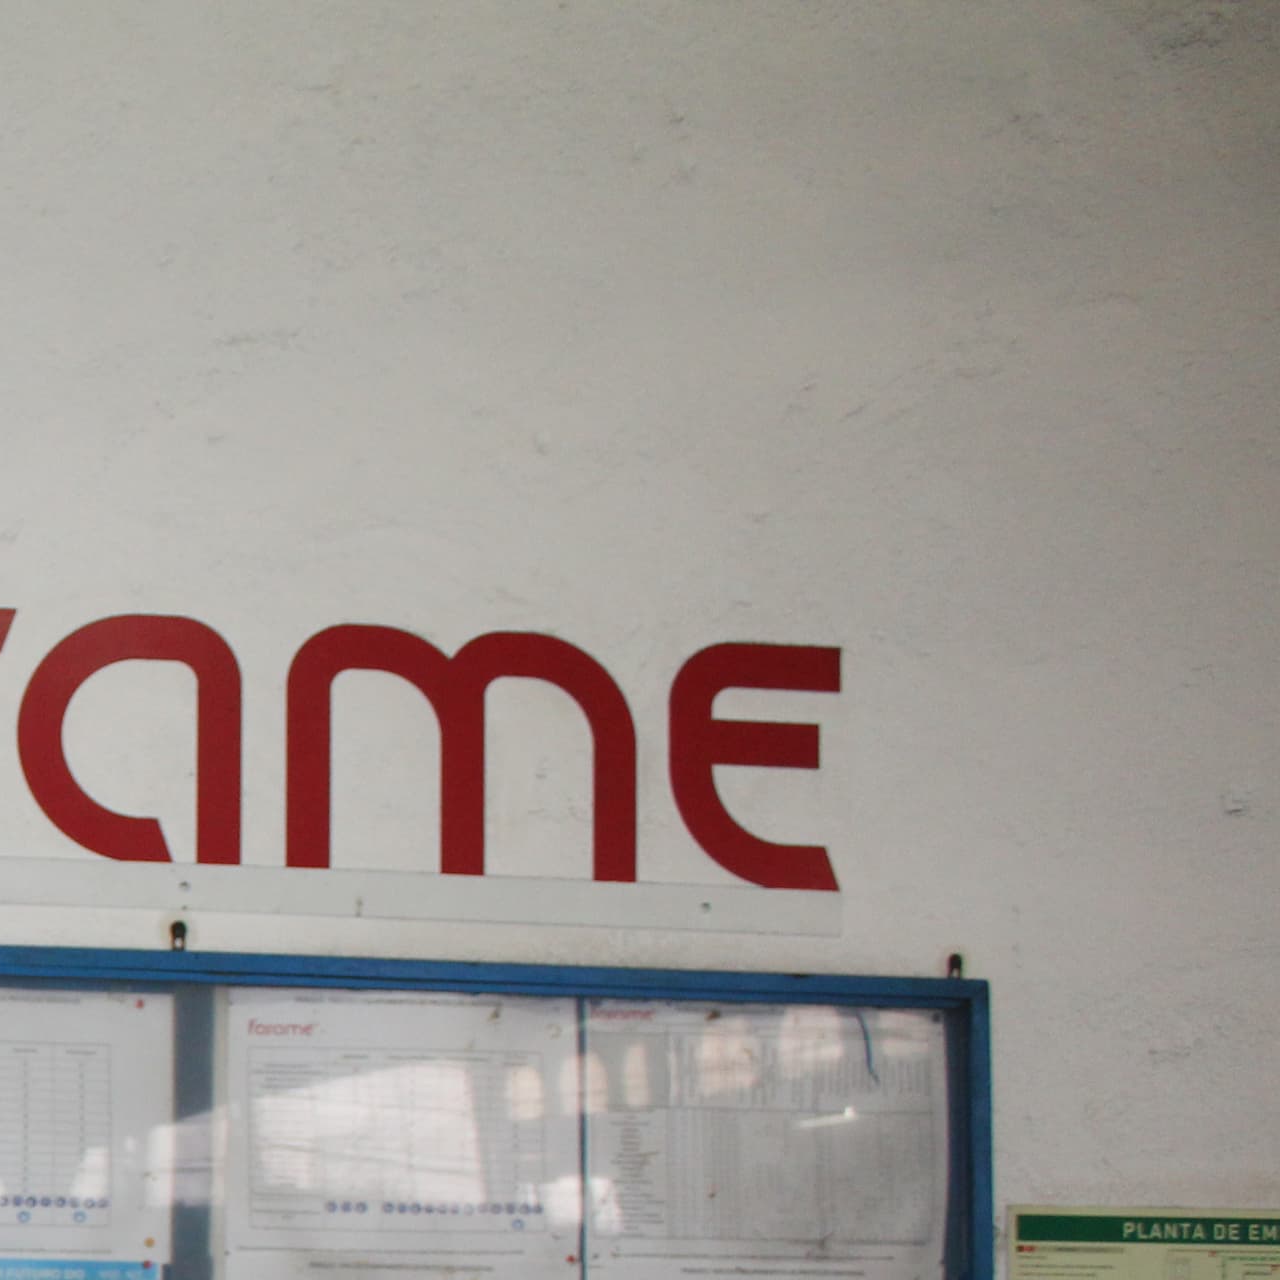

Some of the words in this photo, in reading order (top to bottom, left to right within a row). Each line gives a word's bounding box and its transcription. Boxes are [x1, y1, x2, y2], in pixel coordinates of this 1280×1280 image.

[1122, 1221, 1207, 1240] PLANTA
[1213, 1223, 1241, 1241] DE
[1248, 1223, 1280, 1241] EM
